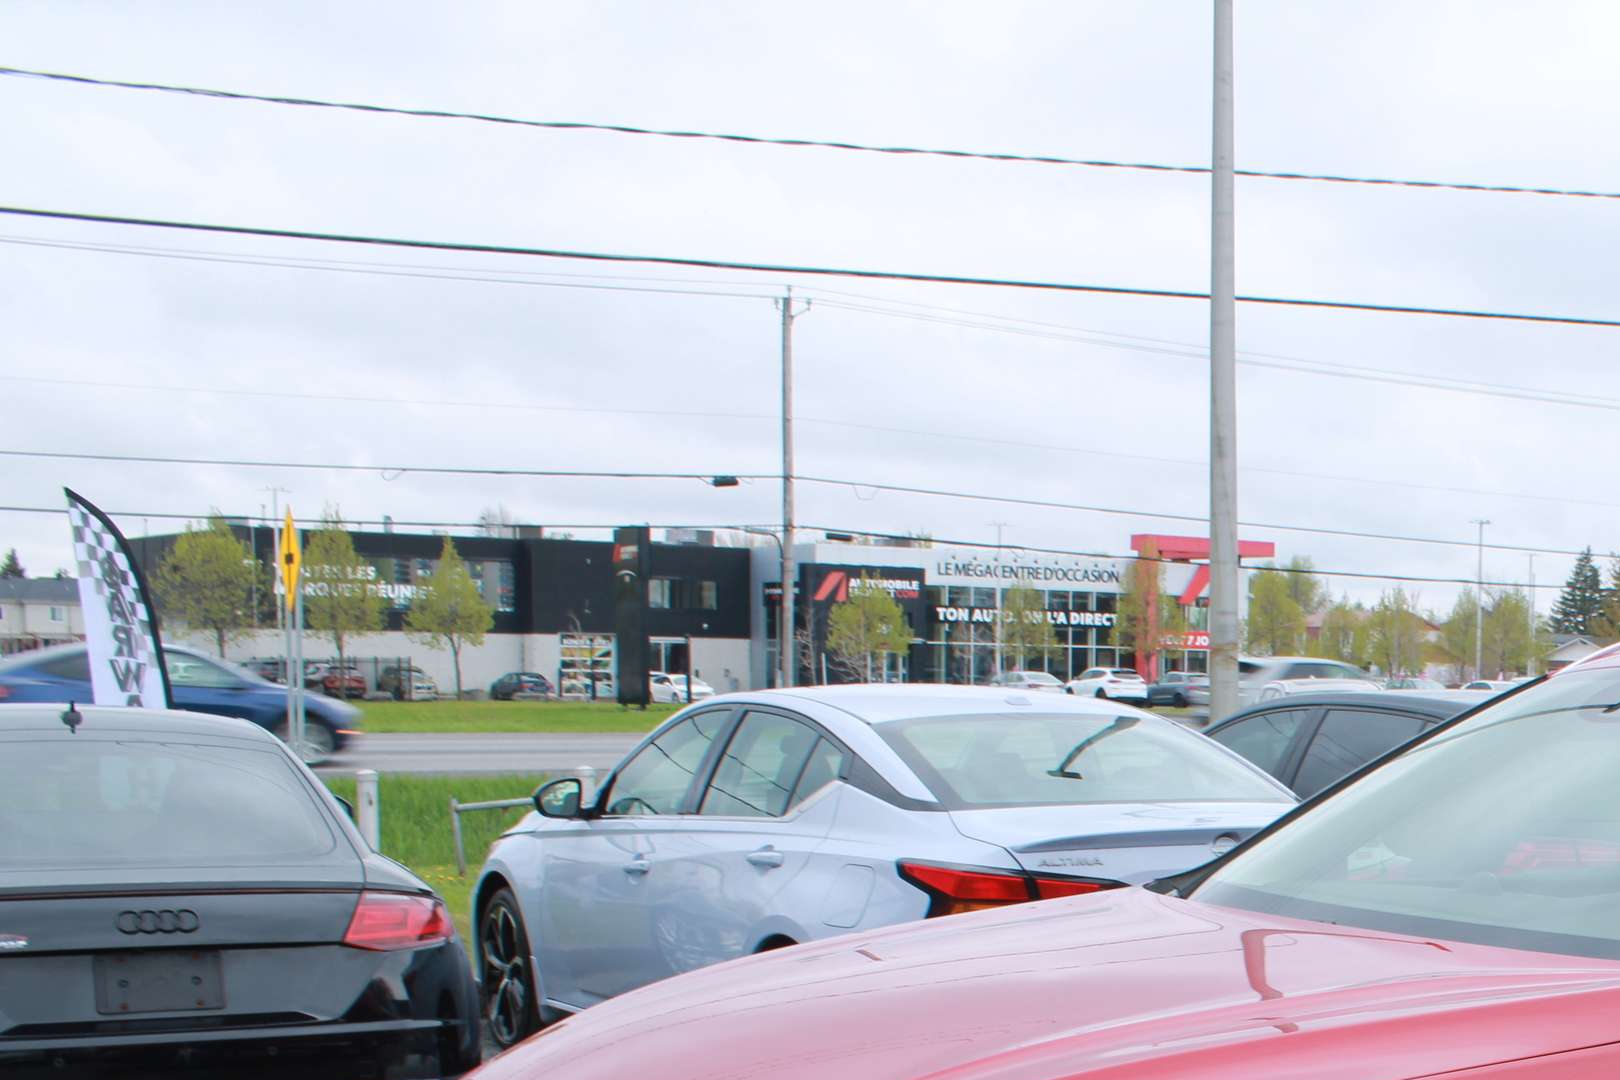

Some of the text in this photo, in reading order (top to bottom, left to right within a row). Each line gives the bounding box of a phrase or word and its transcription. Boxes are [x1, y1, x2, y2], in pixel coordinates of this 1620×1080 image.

[937, 562, 952, 577] LE
[936, 607, 969, 622] TON
[1070, 611, 1118, 626] DIRECT
